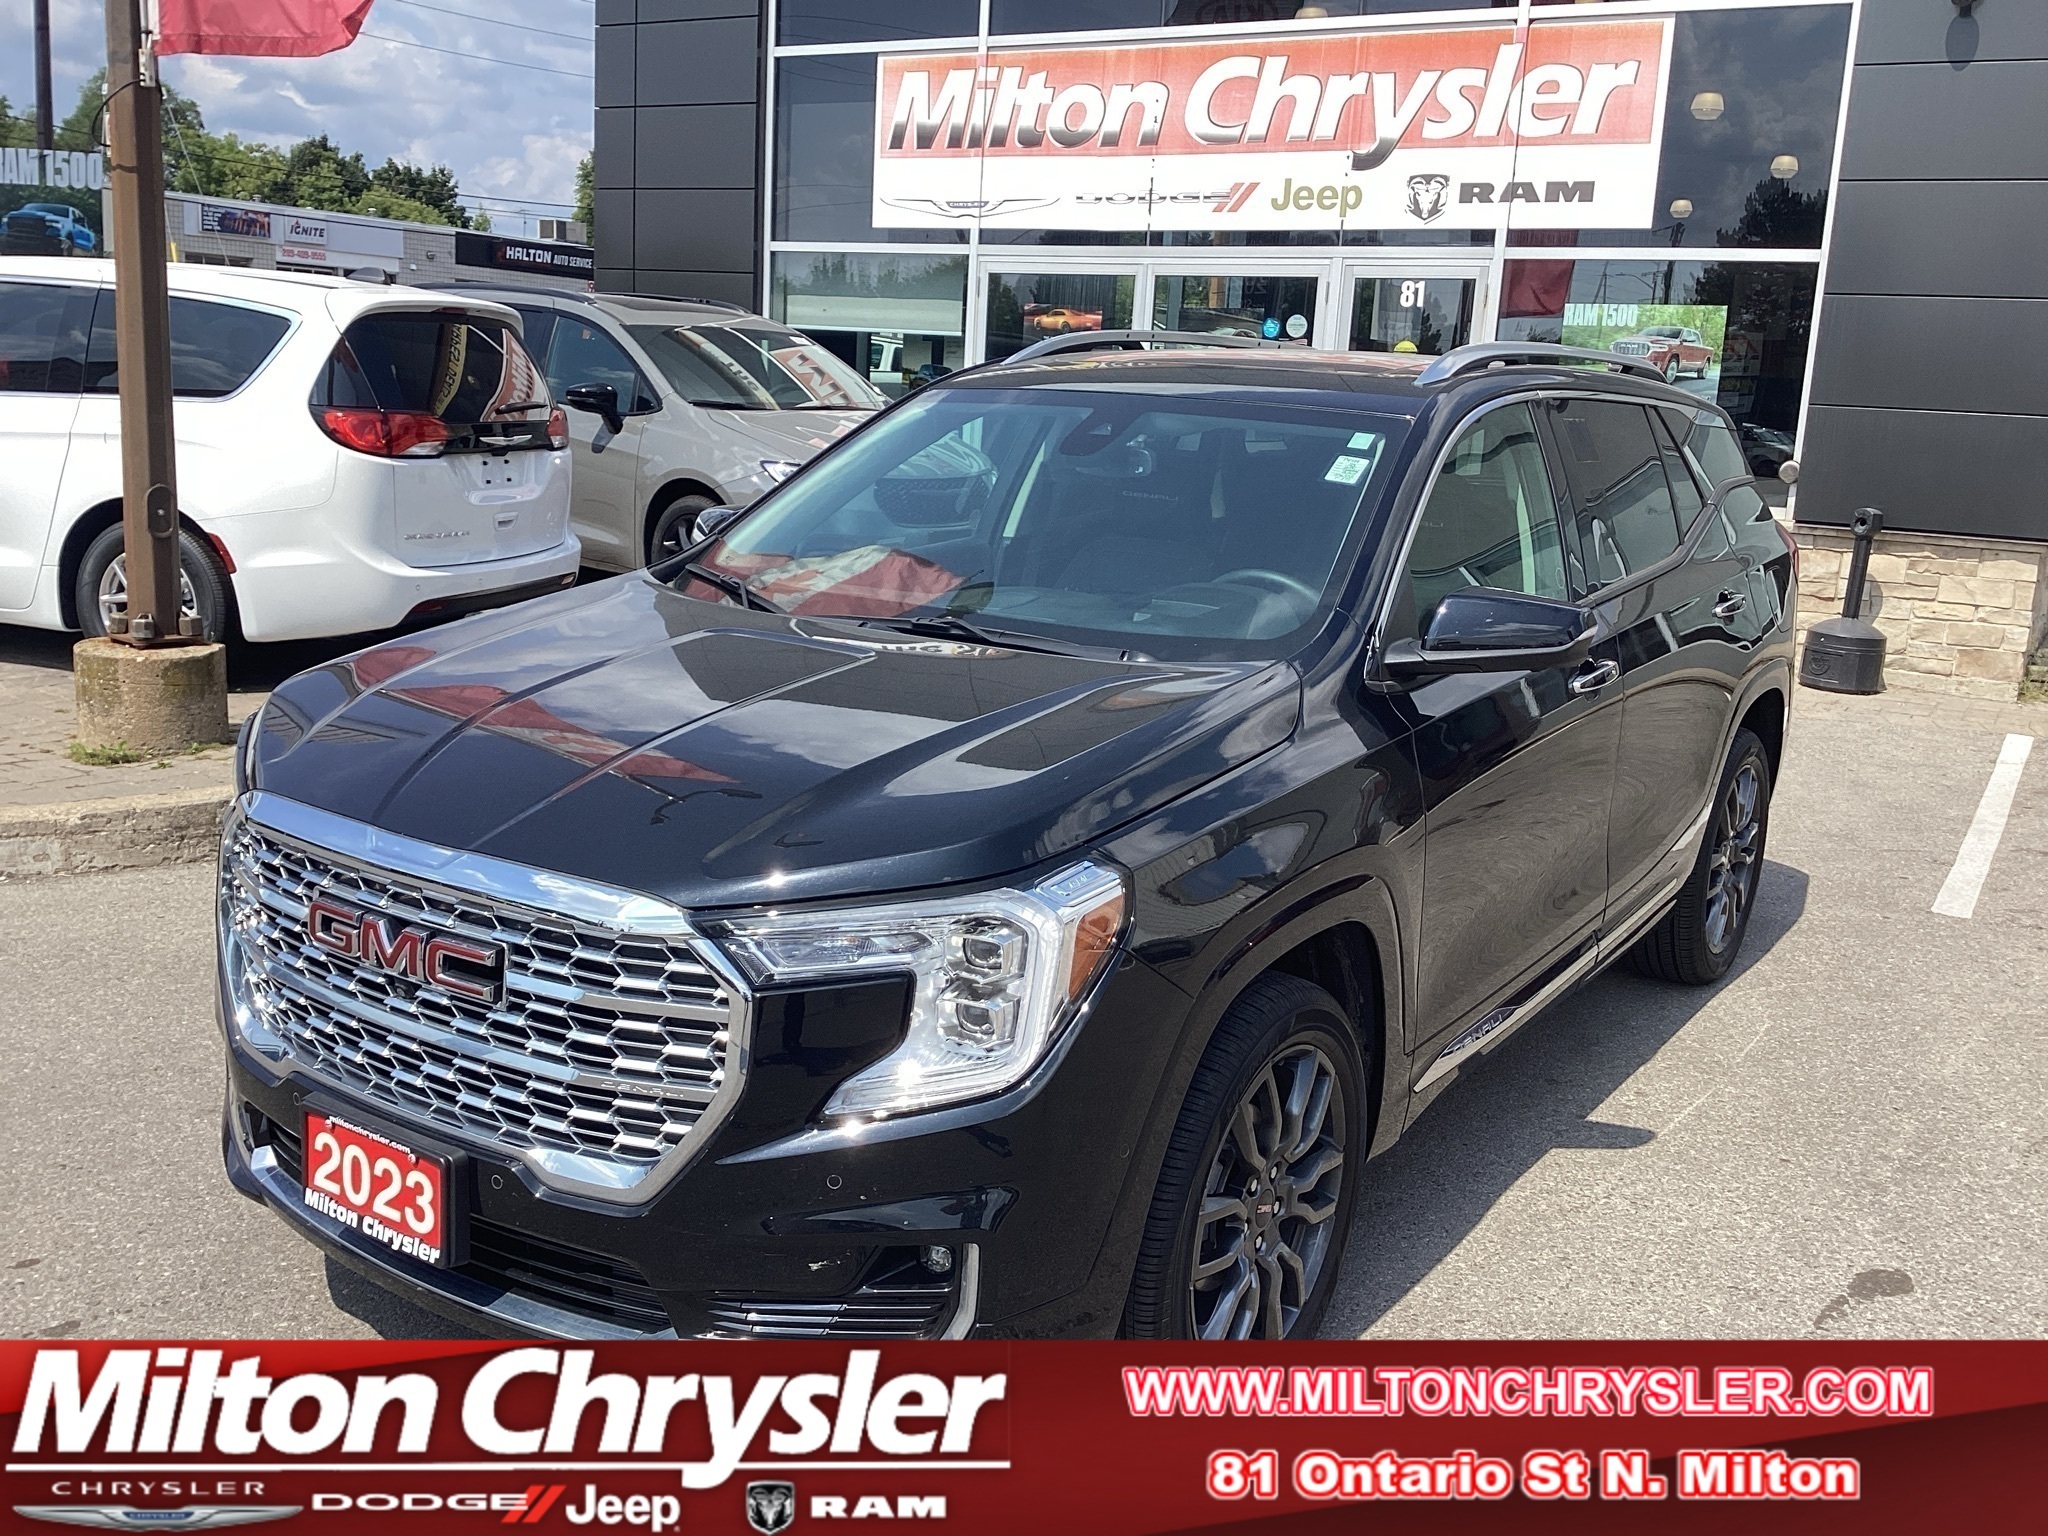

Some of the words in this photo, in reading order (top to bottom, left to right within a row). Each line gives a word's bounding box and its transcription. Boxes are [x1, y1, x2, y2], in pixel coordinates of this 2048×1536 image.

[889, 62, 1167, 150] Milton
[1192, 42, 1640, 171] Chrysler
[0, 147, 39, 185] AM
[43, 149, 103, 190] 1500
[1075, 188, 1232, 205] DODGE
[1271, 178, 1363, 218] Jeep
[1458, 180, 1595, 204] RAM
[290, 222, 325, 237] IGNITE
[506, 246, 552, 264] HALTON
[553, 255, 569, 266] AUTO
[569, 256, 593, 269] SERVICE
[1400, 280, 1426, 308] 81
[1563, 303, 1598, 327] RAM
[1602, 303, 1639, 327] 1500
[308, 896, 498, 1003] GMC
[314, 1131, 435, 1235] 2023
[304, 1187, 358, 1229] Milton
[362, 1214, 441, 1264] Chrysler
